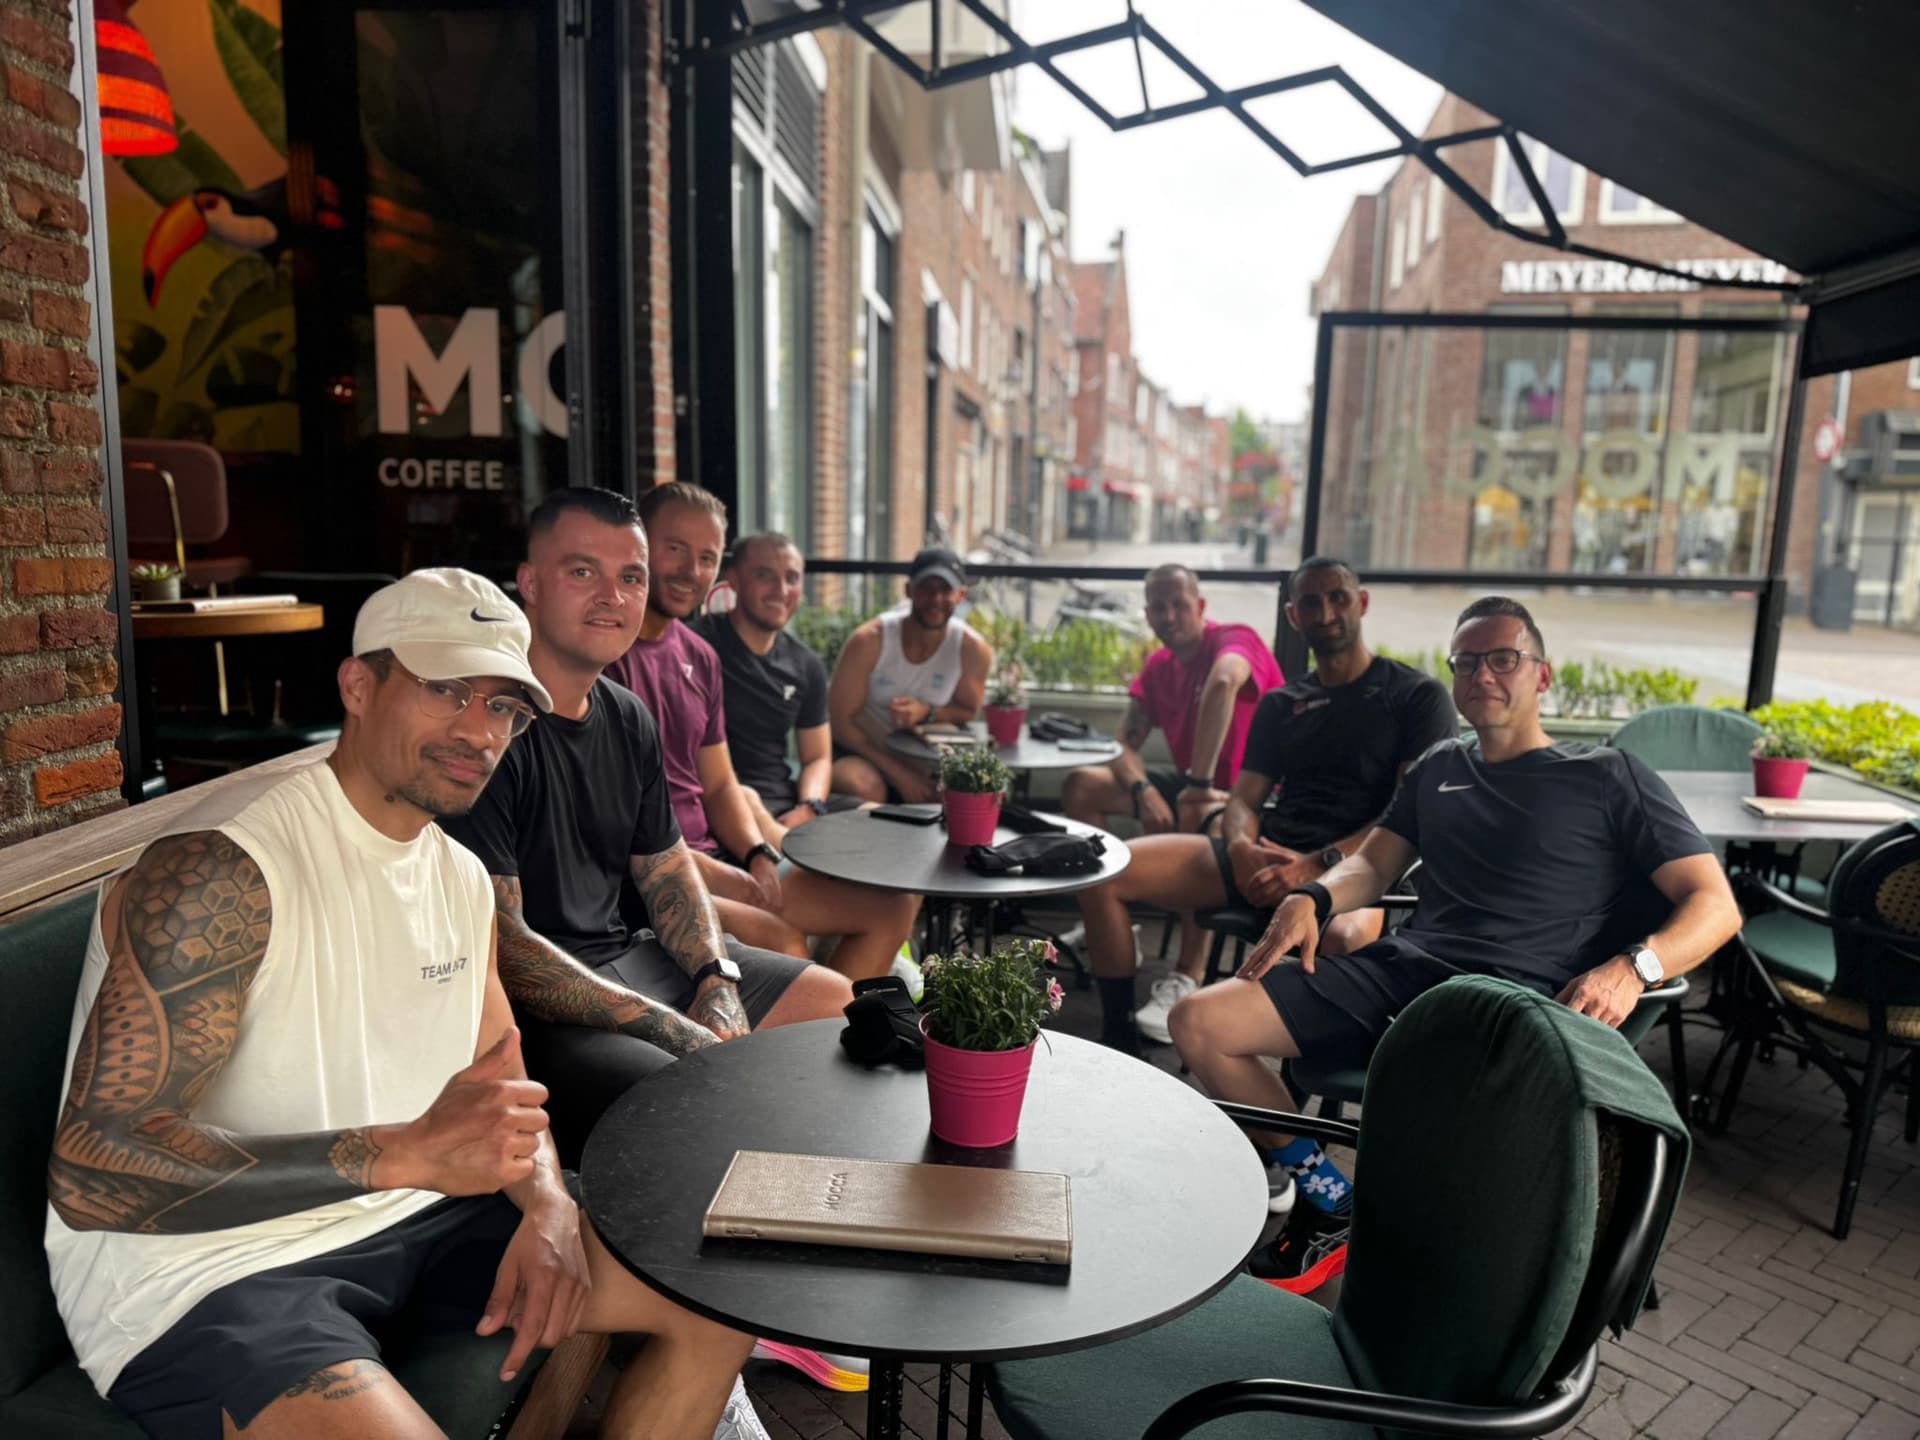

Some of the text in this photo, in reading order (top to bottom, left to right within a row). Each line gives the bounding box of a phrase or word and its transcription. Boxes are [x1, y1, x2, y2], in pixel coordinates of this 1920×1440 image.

[378, 457, 504, 490] COFFEE
[421, 962, 452, 979] TEAM
[822, 1172, 848, 1210] MOCCA
